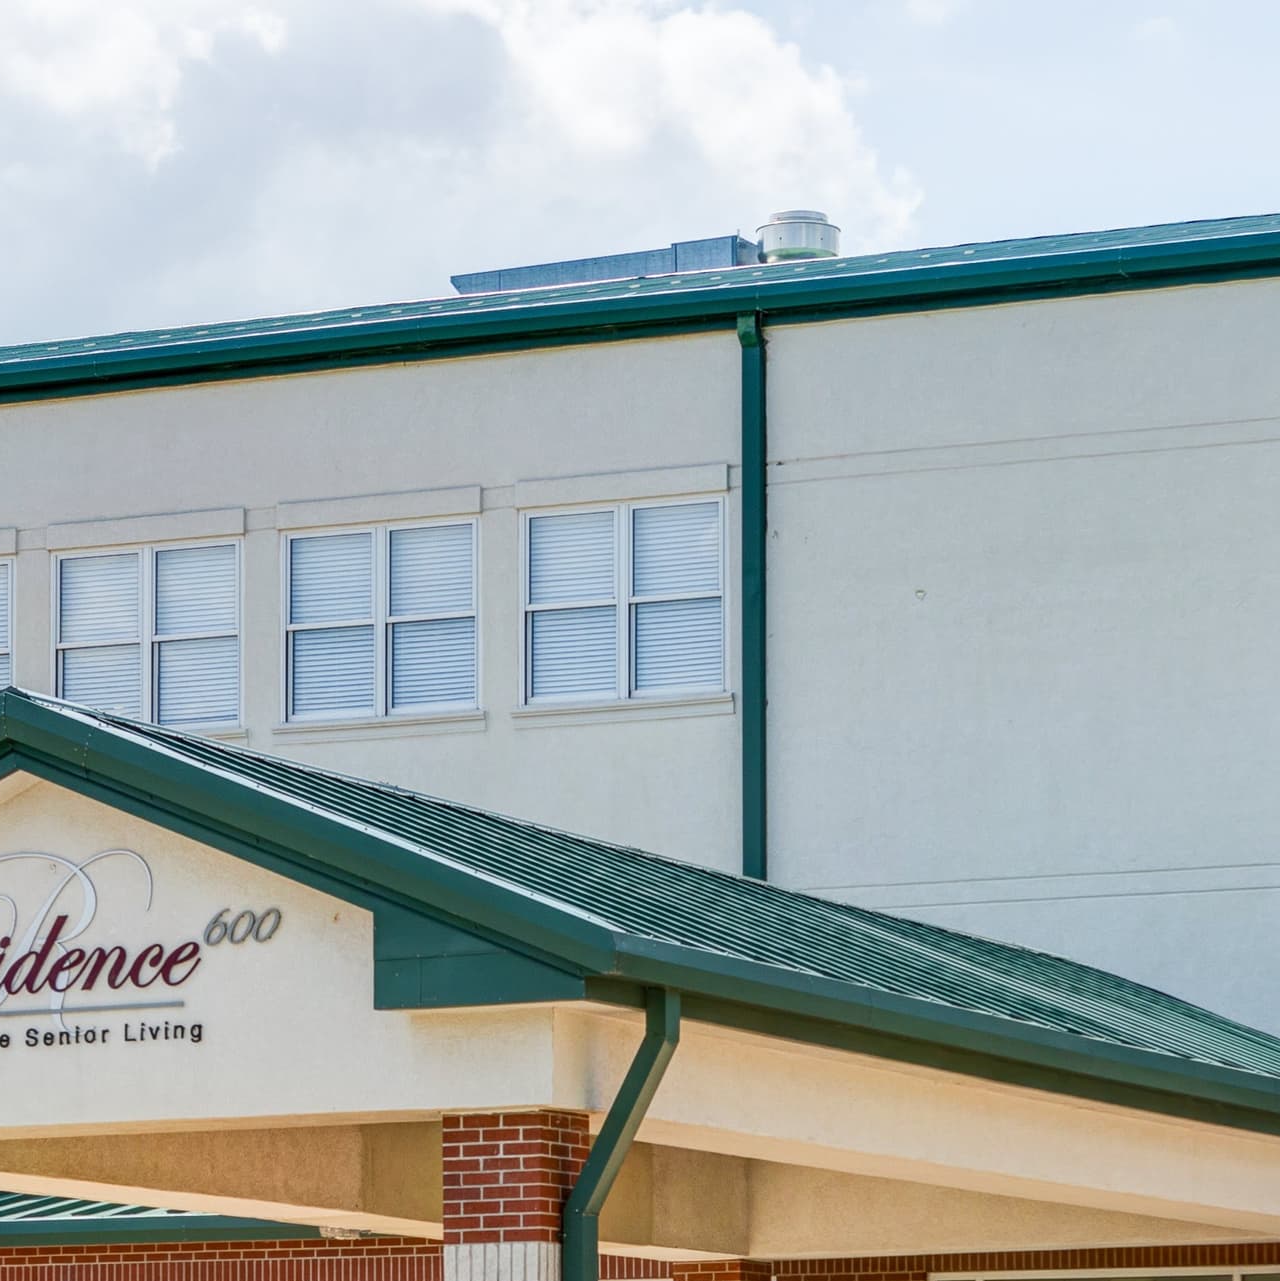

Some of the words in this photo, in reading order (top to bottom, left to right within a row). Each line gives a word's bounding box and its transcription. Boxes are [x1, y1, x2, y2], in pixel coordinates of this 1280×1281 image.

[203, 908, 281, 946] 600
[25, 1026, 110, 1047] Senior
[124, 1021, 203, 1043] Living
